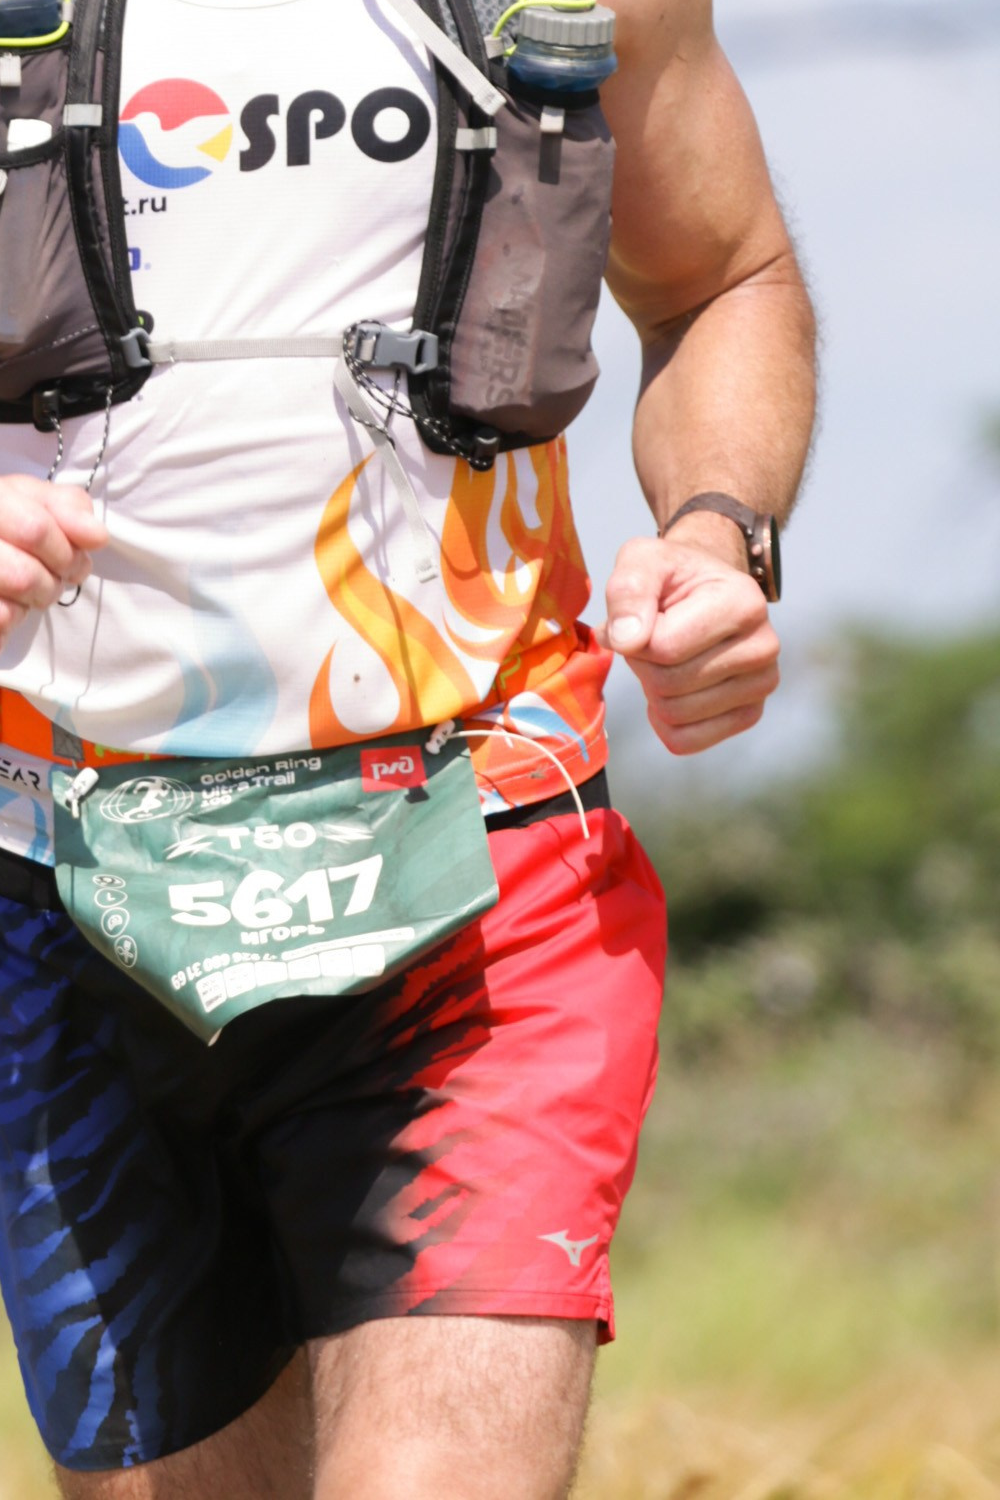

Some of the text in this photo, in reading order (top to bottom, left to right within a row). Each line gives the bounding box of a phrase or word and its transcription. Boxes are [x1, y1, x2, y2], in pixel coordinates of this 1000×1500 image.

[239, 86, 431, 172] SPO
[200, 756, 322, 785] Golden Ring
[201, 772, 296, 800] Ultra Trail
[216, 821, 317, 849] T50
[168, 853, 383, 928] 5617
[240, 924, 326, 945] ИГОРЬ
[171, 969, 187, 991] 69
[186, 961, 203, 983] 31
